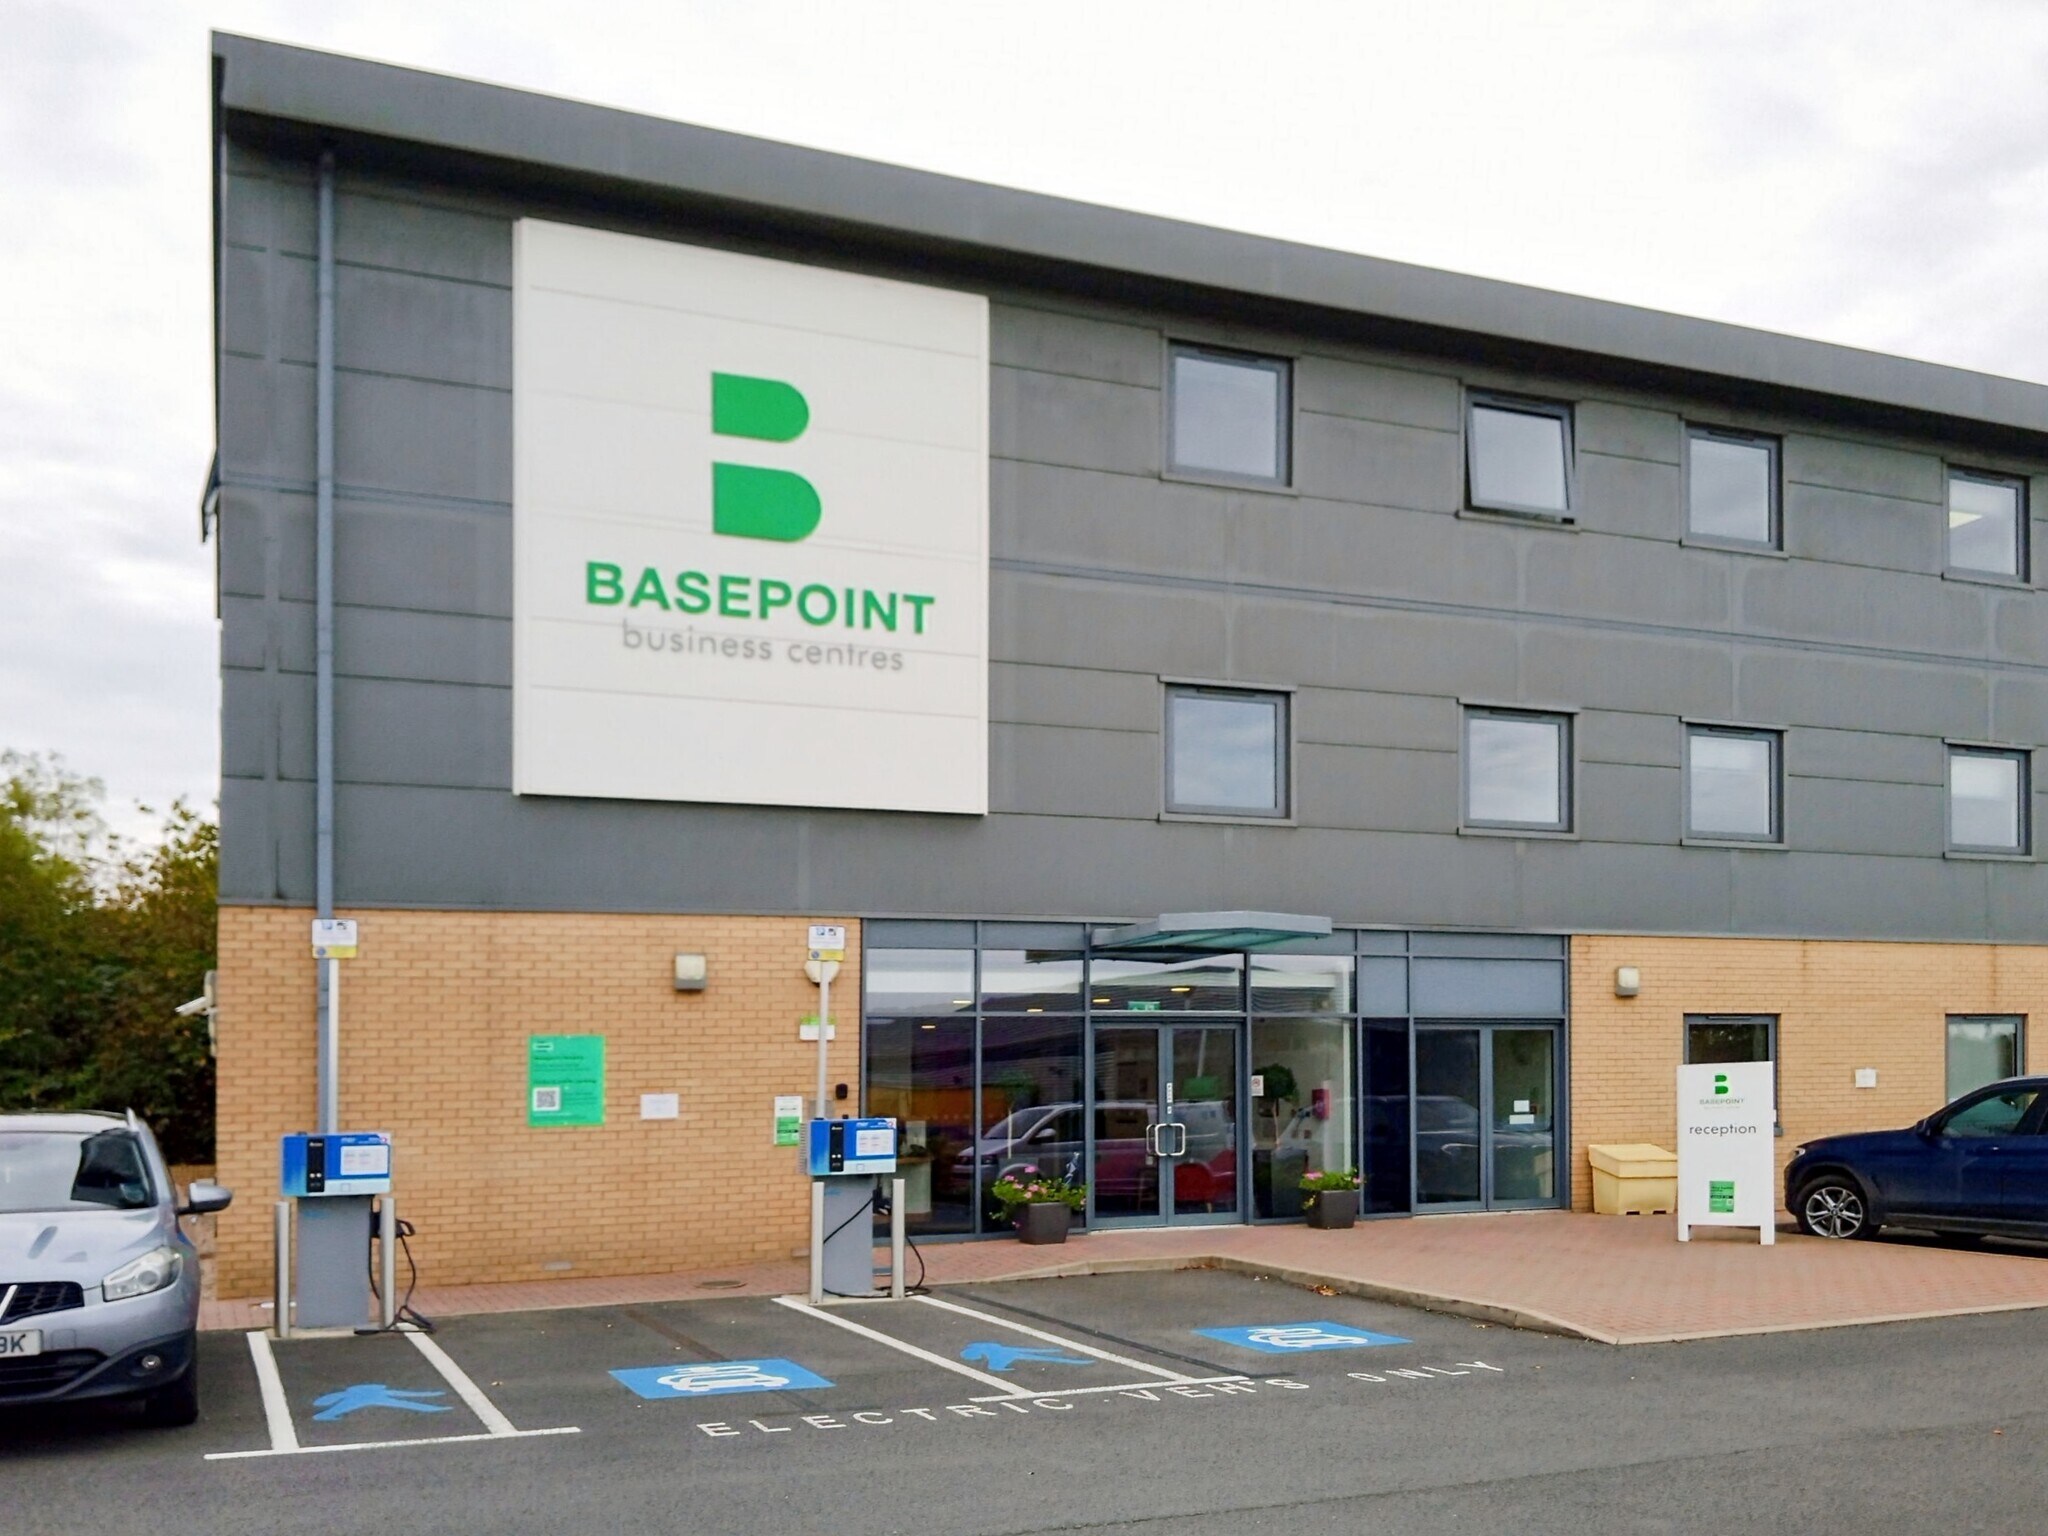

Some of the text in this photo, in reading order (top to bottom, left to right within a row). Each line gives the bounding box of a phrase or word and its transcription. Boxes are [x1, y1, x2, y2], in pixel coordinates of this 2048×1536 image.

[586, 561, 935, 634] BASEPOINT
[622, 618, 904, 671] business centres
[1689, 1124, 1757, 1137] reception
[697, 1397, 1073, 1437] ELECTRIC
[1346, 1360, 1504, 1383] ONLY
